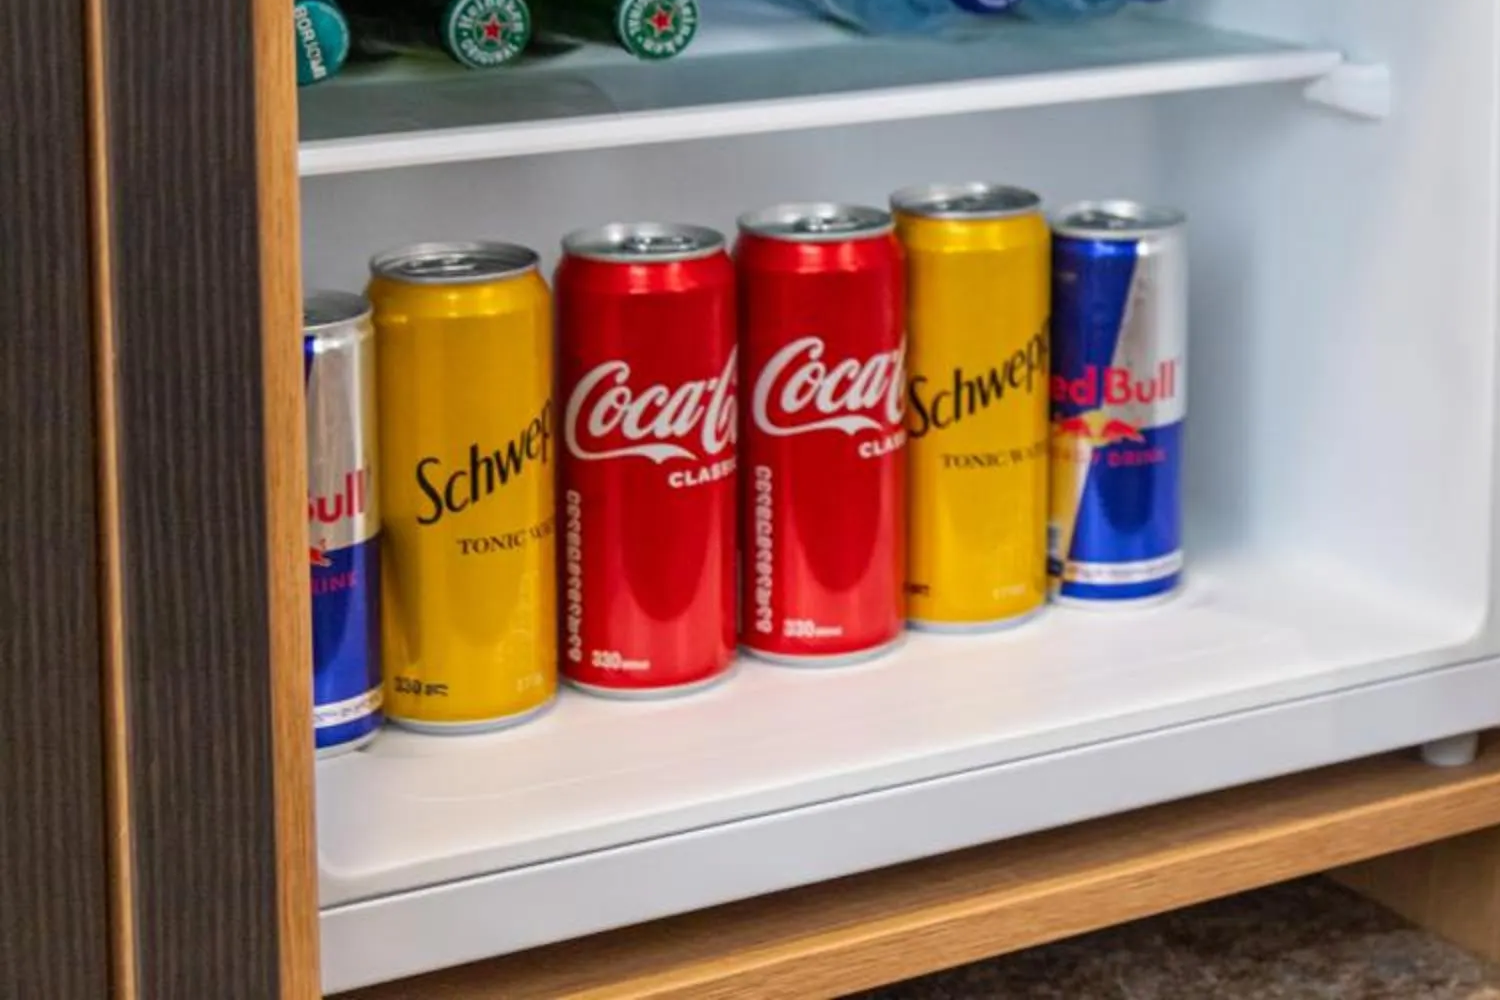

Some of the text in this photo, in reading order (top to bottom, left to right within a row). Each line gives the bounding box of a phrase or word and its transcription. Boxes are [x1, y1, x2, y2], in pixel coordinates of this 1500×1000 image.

[1103, 358, 1176, 406] Bull
[415, 398, 554, 526] Schwep
[456, 528, 526, 556] TONIC
